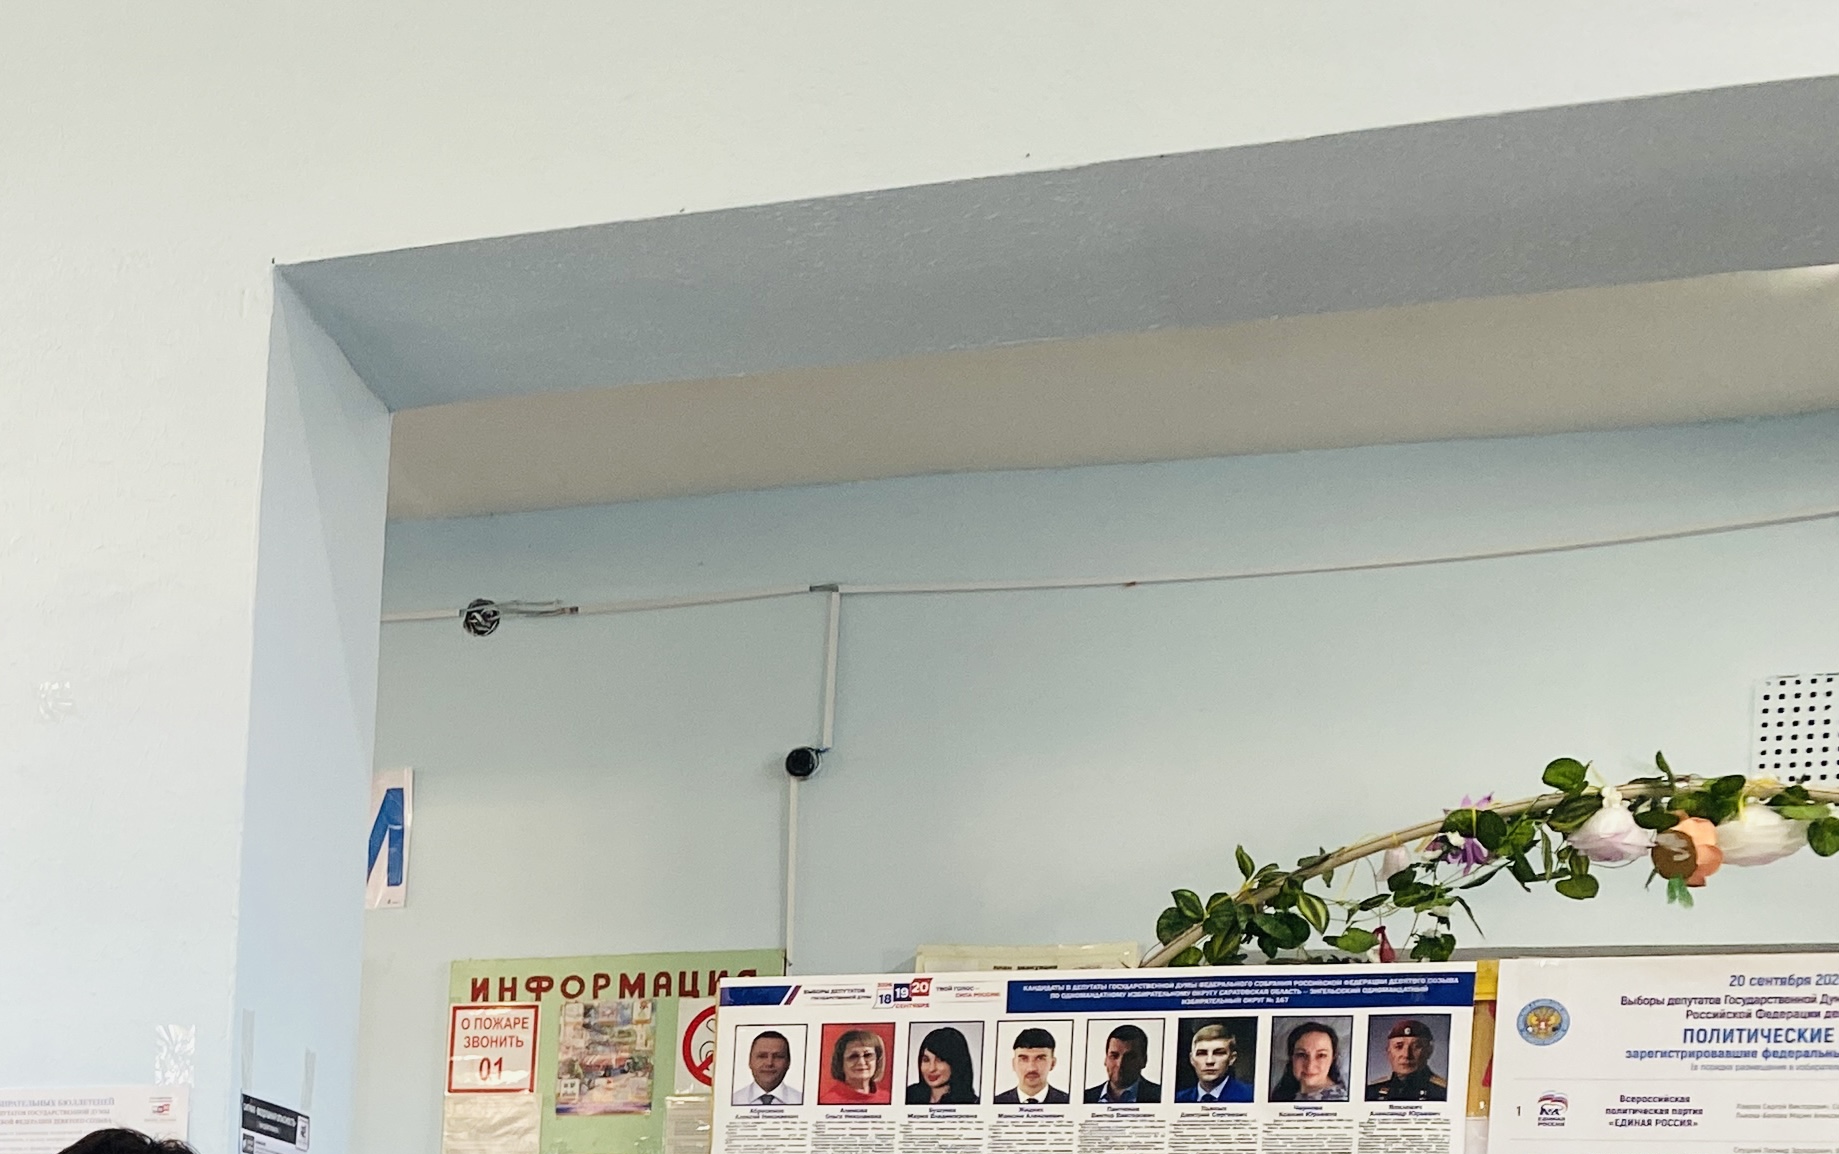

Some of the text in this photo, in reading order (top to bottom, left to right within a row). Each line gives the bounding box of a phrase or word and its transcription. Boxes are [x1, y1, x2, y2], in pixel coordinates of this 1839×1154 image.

[1729, 975, 1744, 987] 20
[1749, 974, 1811, 988] сентября
[895, 987, 909, 999] 19
[911, 982, 929, 993] 20
[879, 994, 892, 1004] 18
[1620, 995, 1665, 1007] Выборы
[1667, 996, 1721, 1006] депутатов
[1724, 994, 1817, 1006] Государственной
[1686, 1008, 1752, 1019] Российской
[1755, 1009, 1820, 1020] Федерации
[461, 1017, 529, 1031] О ПОЖАРЕ
[464, 1034, 524, 1049] ЗВОНИТЬ
[1683, 1027, 1835, 1044] ПОЛИТИЧЕСКИЕ
[1625, 1049, 1758, 1061] зарегистрировавшие
[479, 1056, 504, 1081] 01
[1620, 1095, 1690, 1104] Всероссийская
[1516, 1106, 1522, 1117] 1
[1672, 1108, 1703, 1117] партия
[1609, 1118, 1698, 1128] «ЕДИНАЯ РОССИЯ»
